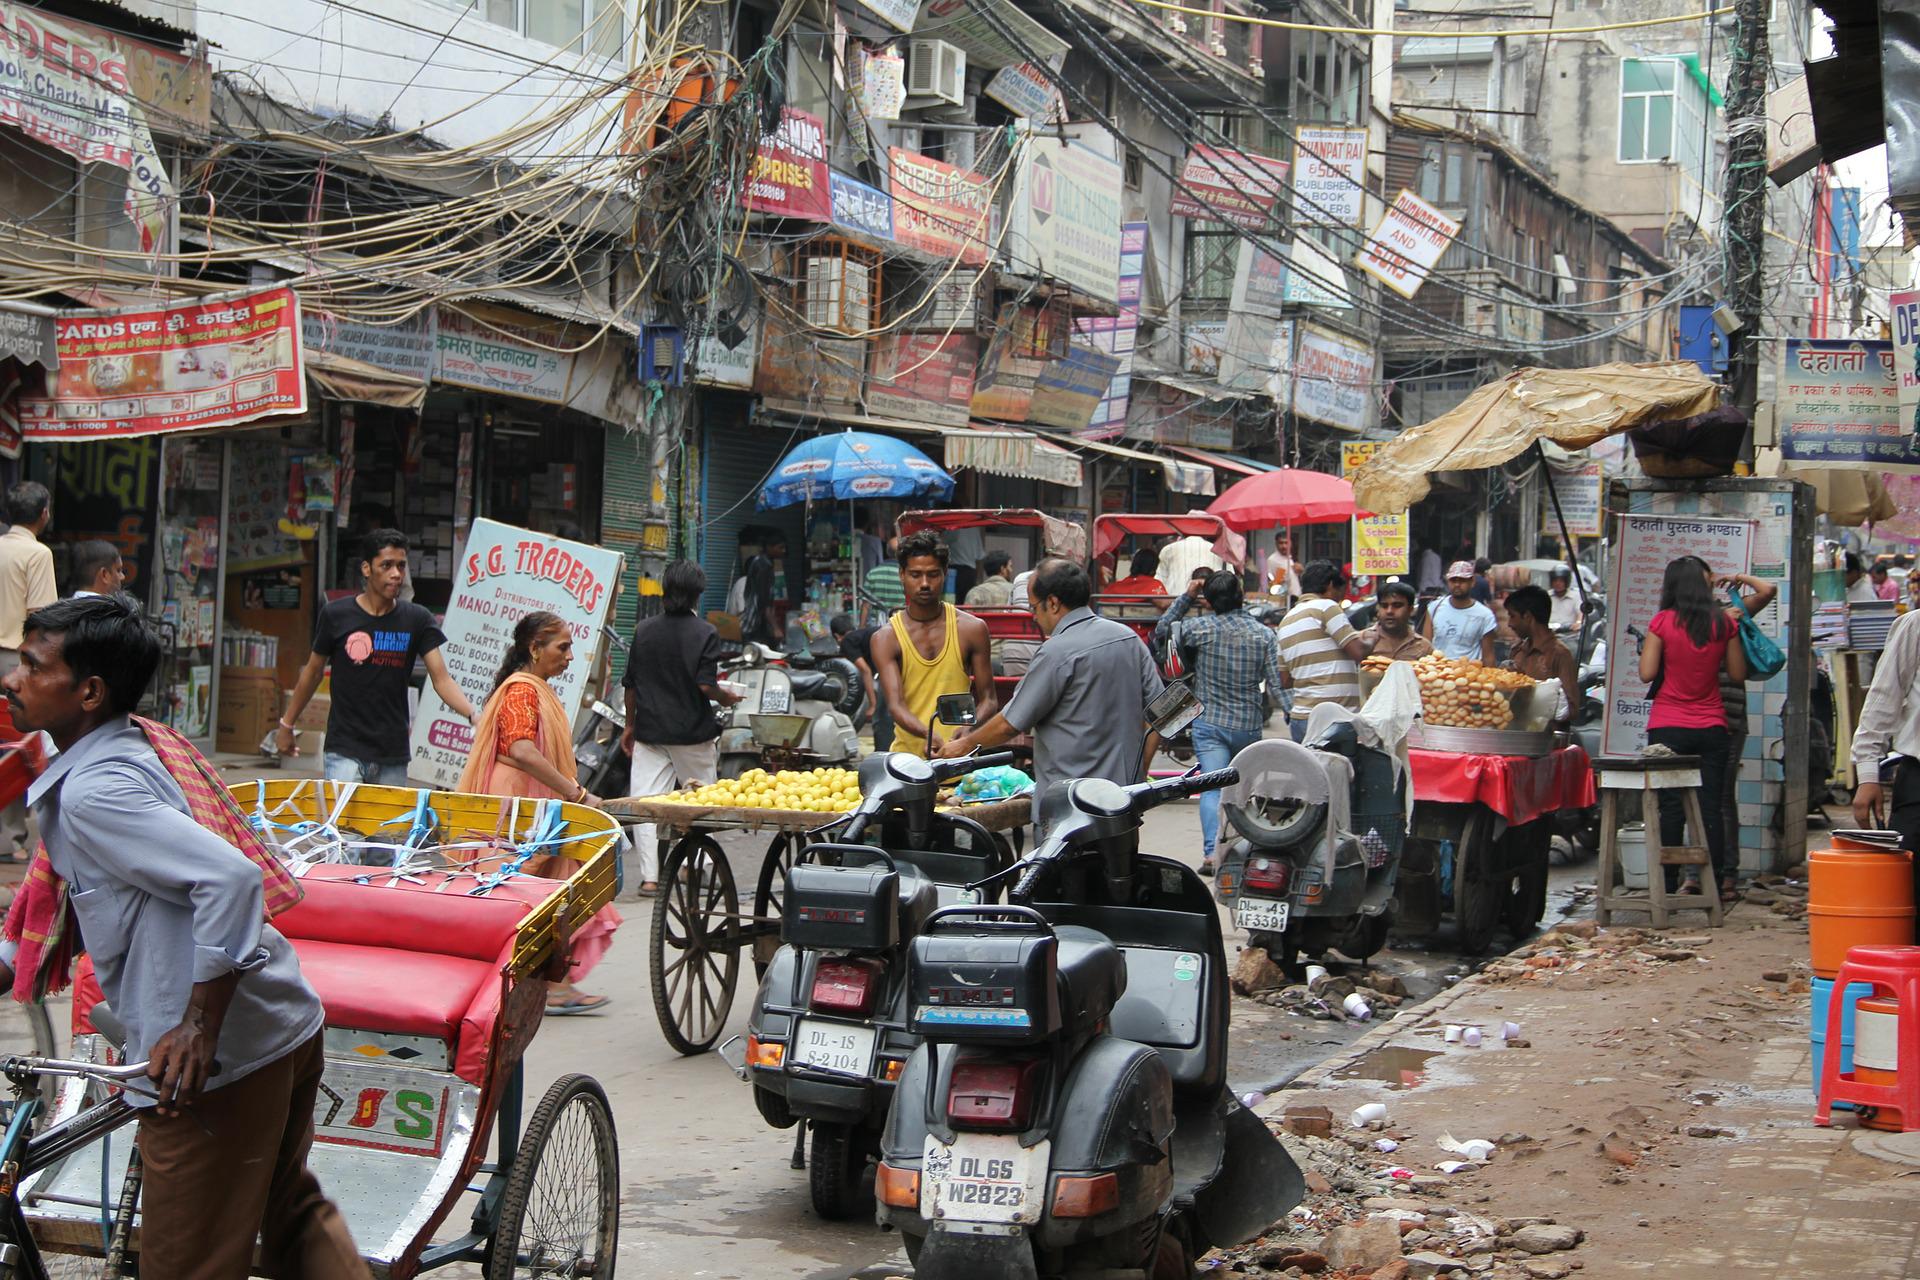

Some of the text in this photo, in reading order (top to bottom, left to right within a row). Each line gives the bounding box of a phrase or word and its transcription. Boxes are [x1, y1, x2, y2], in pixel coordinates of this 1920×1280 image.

[1299, 141, 1363, 160] DHANPAT RAI
[1296, 180, 1361, 192] PUBLISHERS
[1312, 192, 1345, 202] BOOK
[1390, 229, 1417, 250] AND
[474, 340, 539, 369] पुस्तकालय
[1797, 341, 1867, 375] देहाती
[1366, 527, 1398, 537] School
[1631, 517, 1742, 537] देहाती पुस्तक भण्डार
[1360, 547, 1404, 558] COLLEGE
[1364, 559, 1399, 569] BOOKS
[467, 540, 605, 614] S.G. TRADERS
[456, 594, 498, 617] MANOJ
[447, 643, 467, 657] EDU.
[449, 658, 468, 673] COL.
[434, 721, 452, 736] Add
[434, 734, 450, 746] Nai
[416, 746, 432, 761] Ph.
[810, 1031, 828, 1046] DL
[807, 1049, 859, 1071] S-2104
[959, 1157, 1014, 1180] DL6S
[949, 1184, 1023, 1207] W2823
